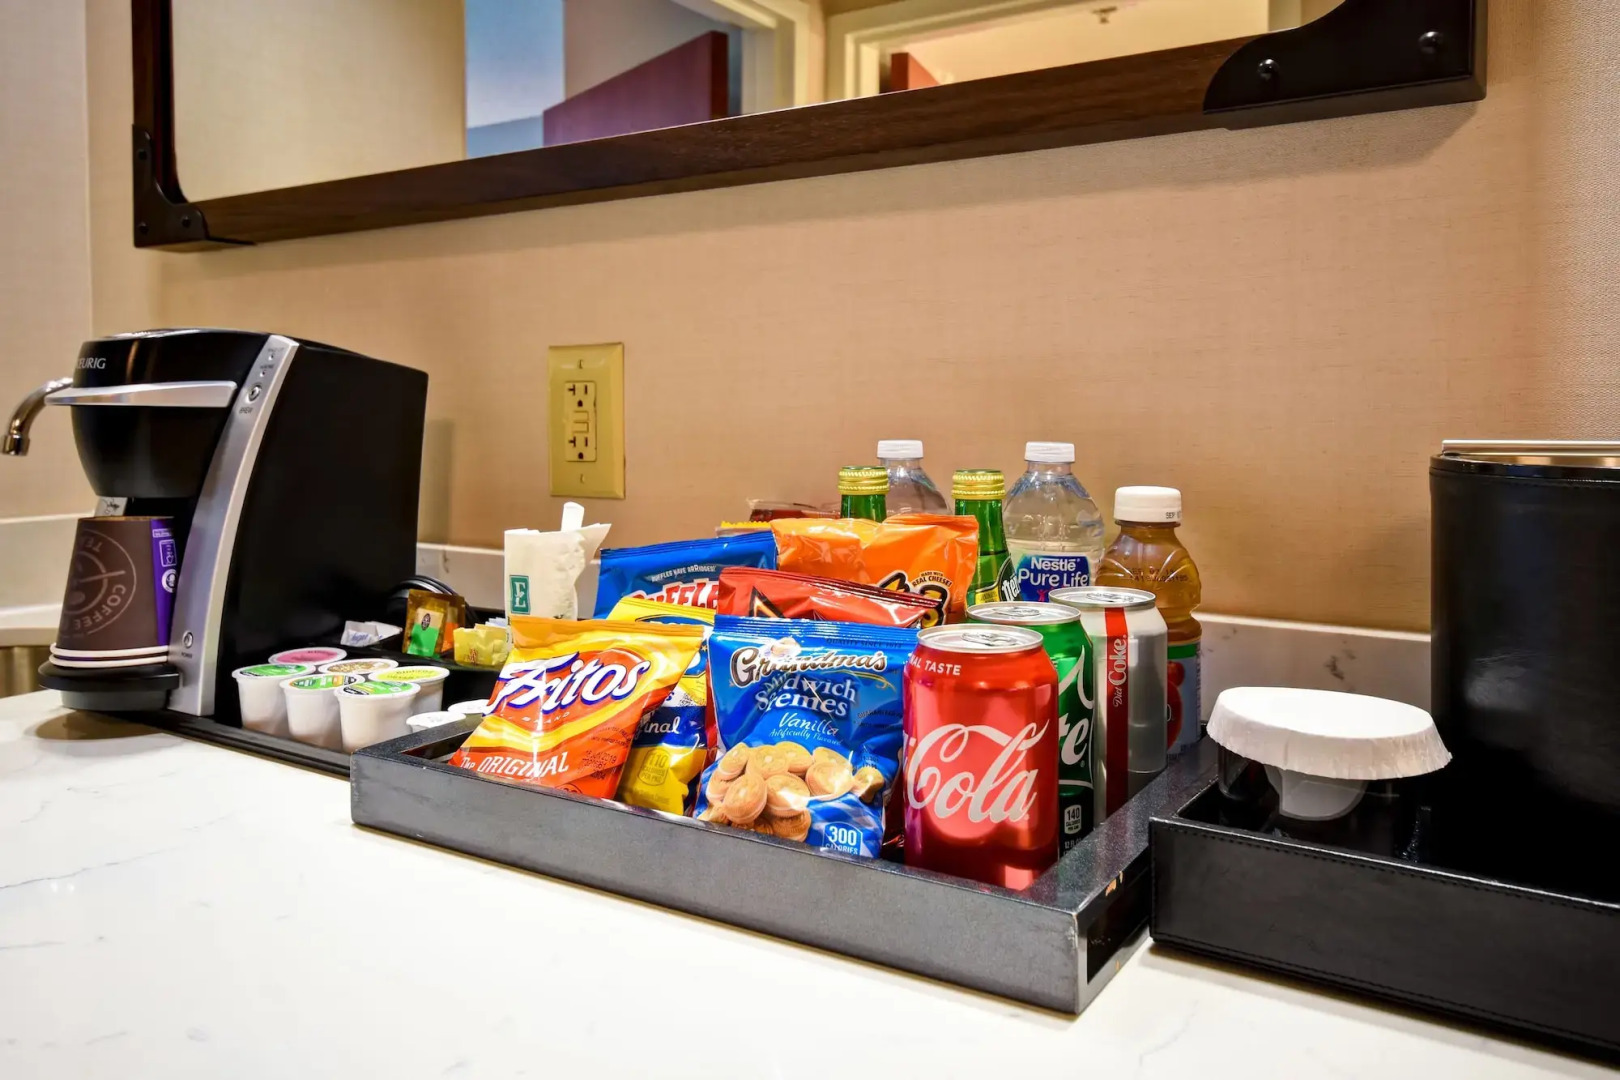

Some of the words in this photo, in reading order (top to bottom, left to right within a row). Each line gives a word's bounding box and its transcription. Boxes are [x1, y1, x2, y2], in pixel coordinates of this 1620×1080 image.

[1030, 557, 1077, 572] Nestlé
[911, 576, 926, 587] REAL
[928, 575, 953, 588] CHEESE!
[1018, 568, 1059, 587] Pure
[1063, 571, 1089, 588] Life
[73, 584, 126, 630] COFFEE
[924, 660, 962, 676] TASTE
[1108, 638, 1127, 686] Coke
[482, 651, 651, 716] Fritos
[1112, 686, 1123, 708] Diet
[778, 711, 840, 737] Vanilla
[477, 751, 569, 779] ORIGINAL
[907, 719, 1050, 824] Cola
[1066, 807, 1080, 821] 140
[829, 826, 857, 846] 300
